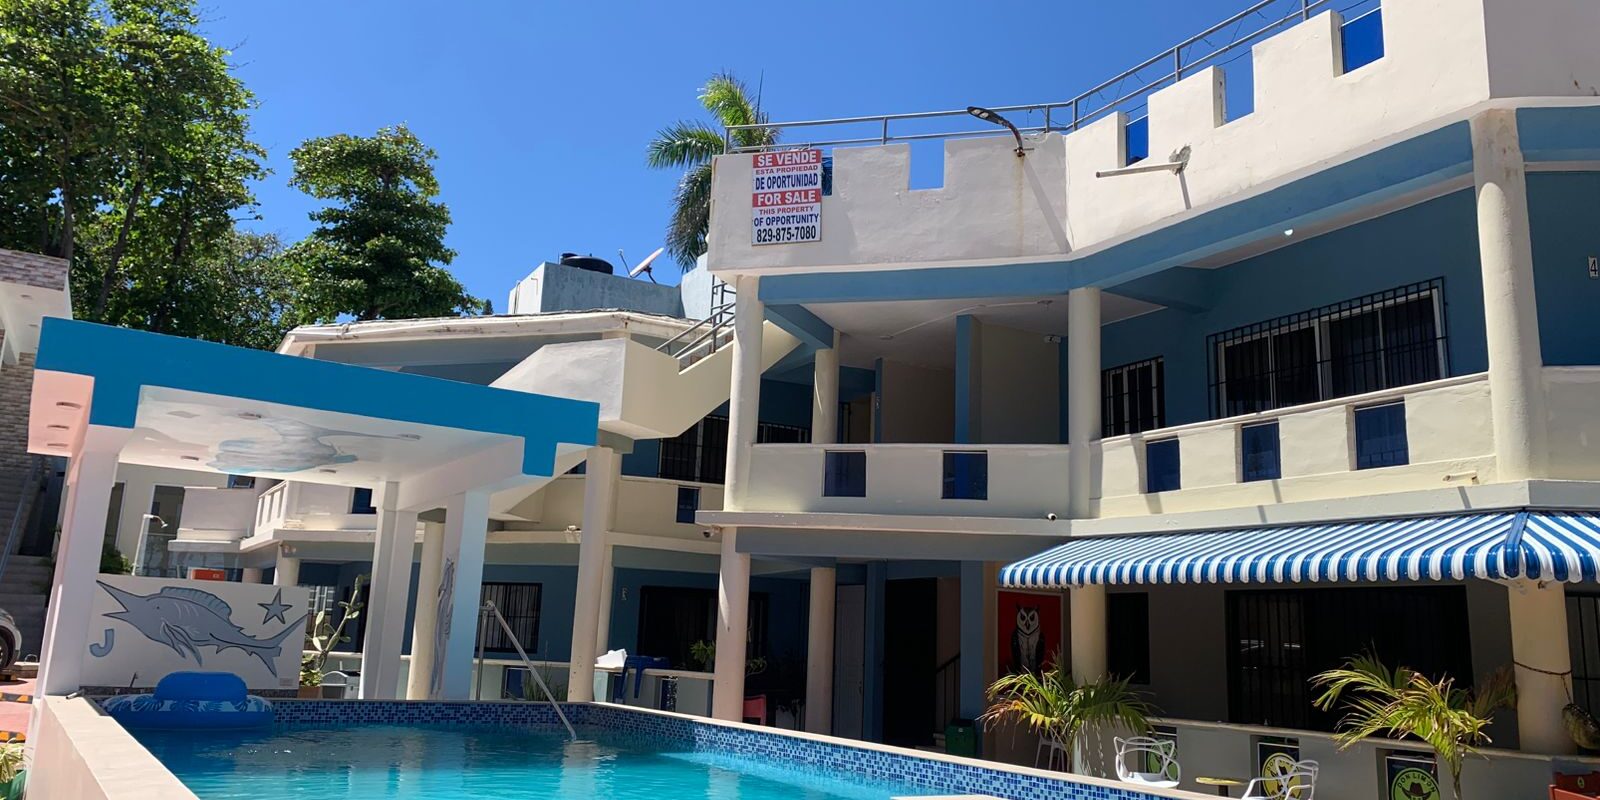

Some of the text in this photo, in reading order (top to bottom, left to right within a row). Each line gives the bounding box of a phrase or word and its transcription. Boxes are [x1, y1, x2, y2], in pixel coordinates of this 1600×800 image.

[758, 151, 817, 167] SE VENDE
[776, 165, 818, 173] PROPIEDAD
[755, 173, 818, 190] DE OPORTUNIDAD
[757, 190, 816, 206] FOR SALE
[777, 206, 814, 214] PROPERTY
[754, 213, 819, 227] OF OPPORTUNITY
[756, 225, 816, 243] 829-875-7080
[1590, 259, 1598, 276] 4
[89, 628, 115, 658] J
[1397, 774, 1411, 789] DON
